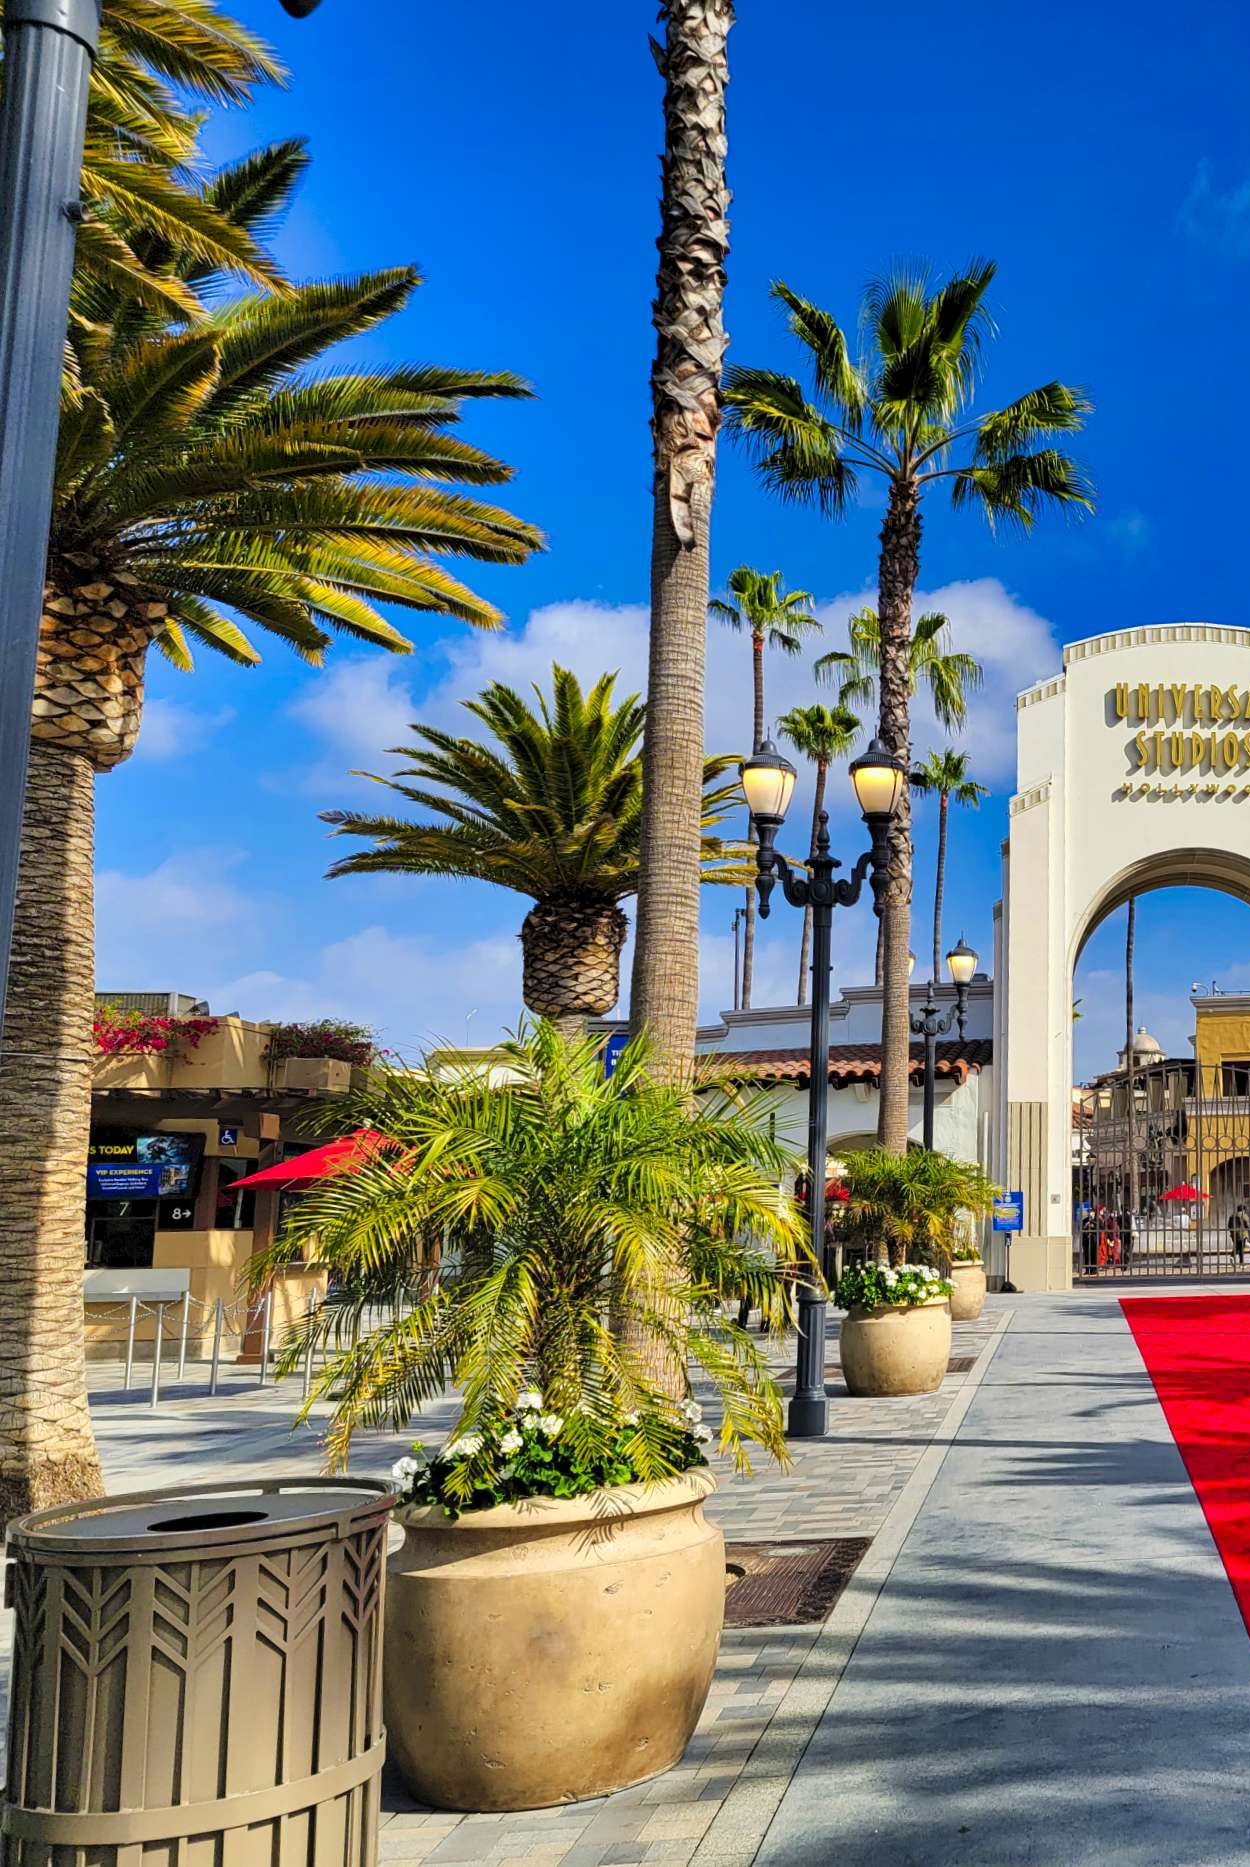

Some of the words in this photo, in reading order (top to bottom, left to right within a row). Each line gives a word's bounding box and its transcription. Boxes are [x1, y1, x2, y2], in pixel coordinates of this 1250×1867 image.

[99, 1145, 134, 1155] TODAY
[120, 1202, 129, 1216] 7
[172, 1208, 182, 1220] 8
